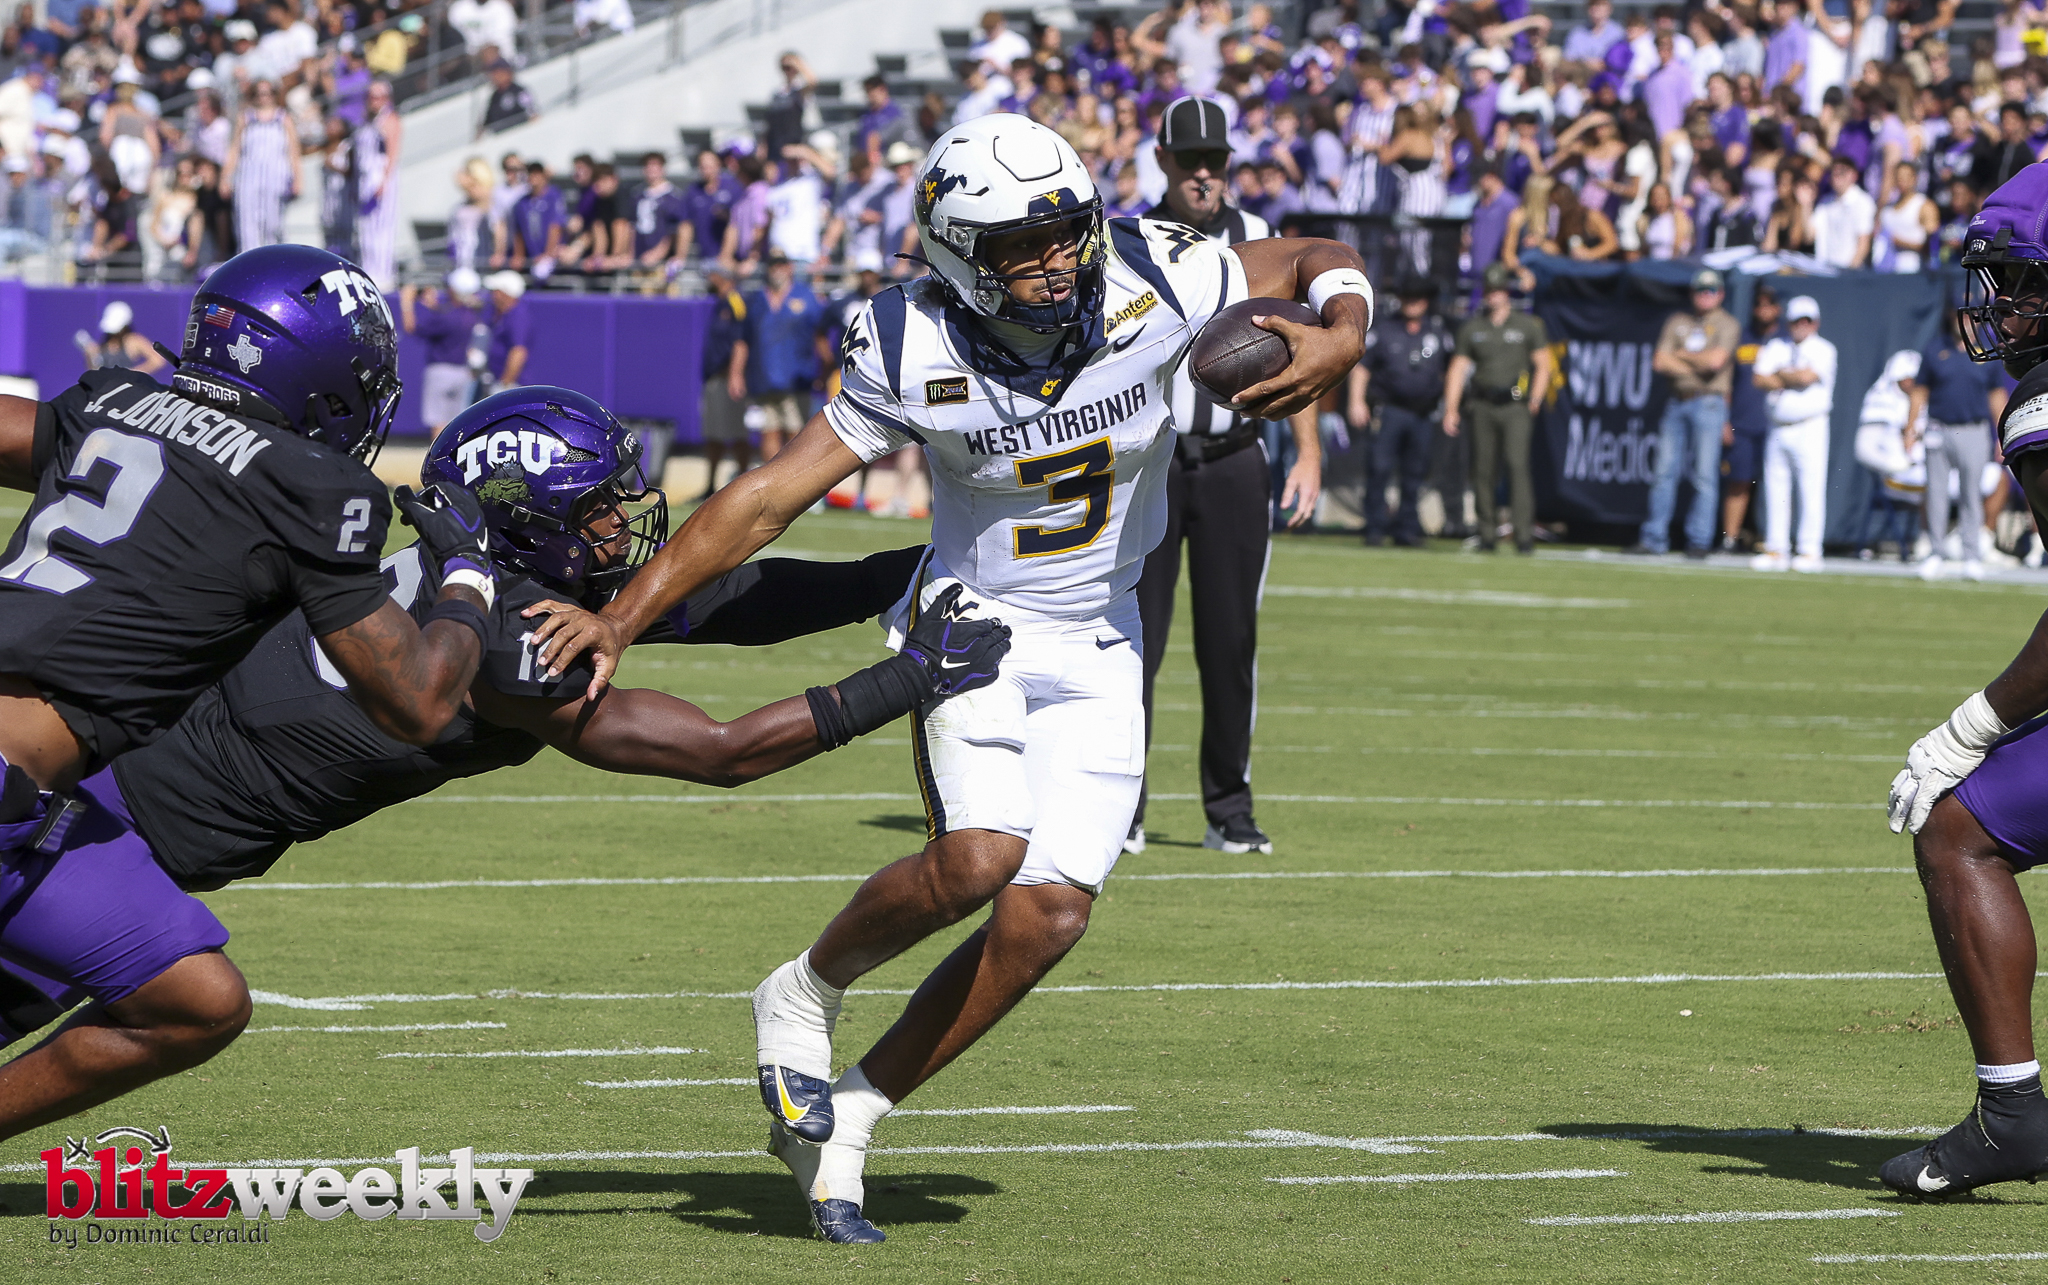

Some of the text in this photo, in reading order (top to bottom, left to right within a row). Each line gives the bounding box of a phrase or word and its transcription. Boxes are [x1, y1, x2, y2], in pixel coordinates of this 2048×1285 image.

[1115, 290, 1154, 322] Antero
[204, 347, 212, 358] 2
[1568, 340, 1654, 411] WVU
[84, 383, 272, 477] J. JOHNSON
[964, 382, 1148, 456] WEST VIRGINIA
[1563, 413, 1661, 484] Medic
[456, 430, 560, 486] TCU
[0, 427, 168, 596] 2
[336, 496, 372, 553] 2
[1012, 436, 1115, 560] 3
